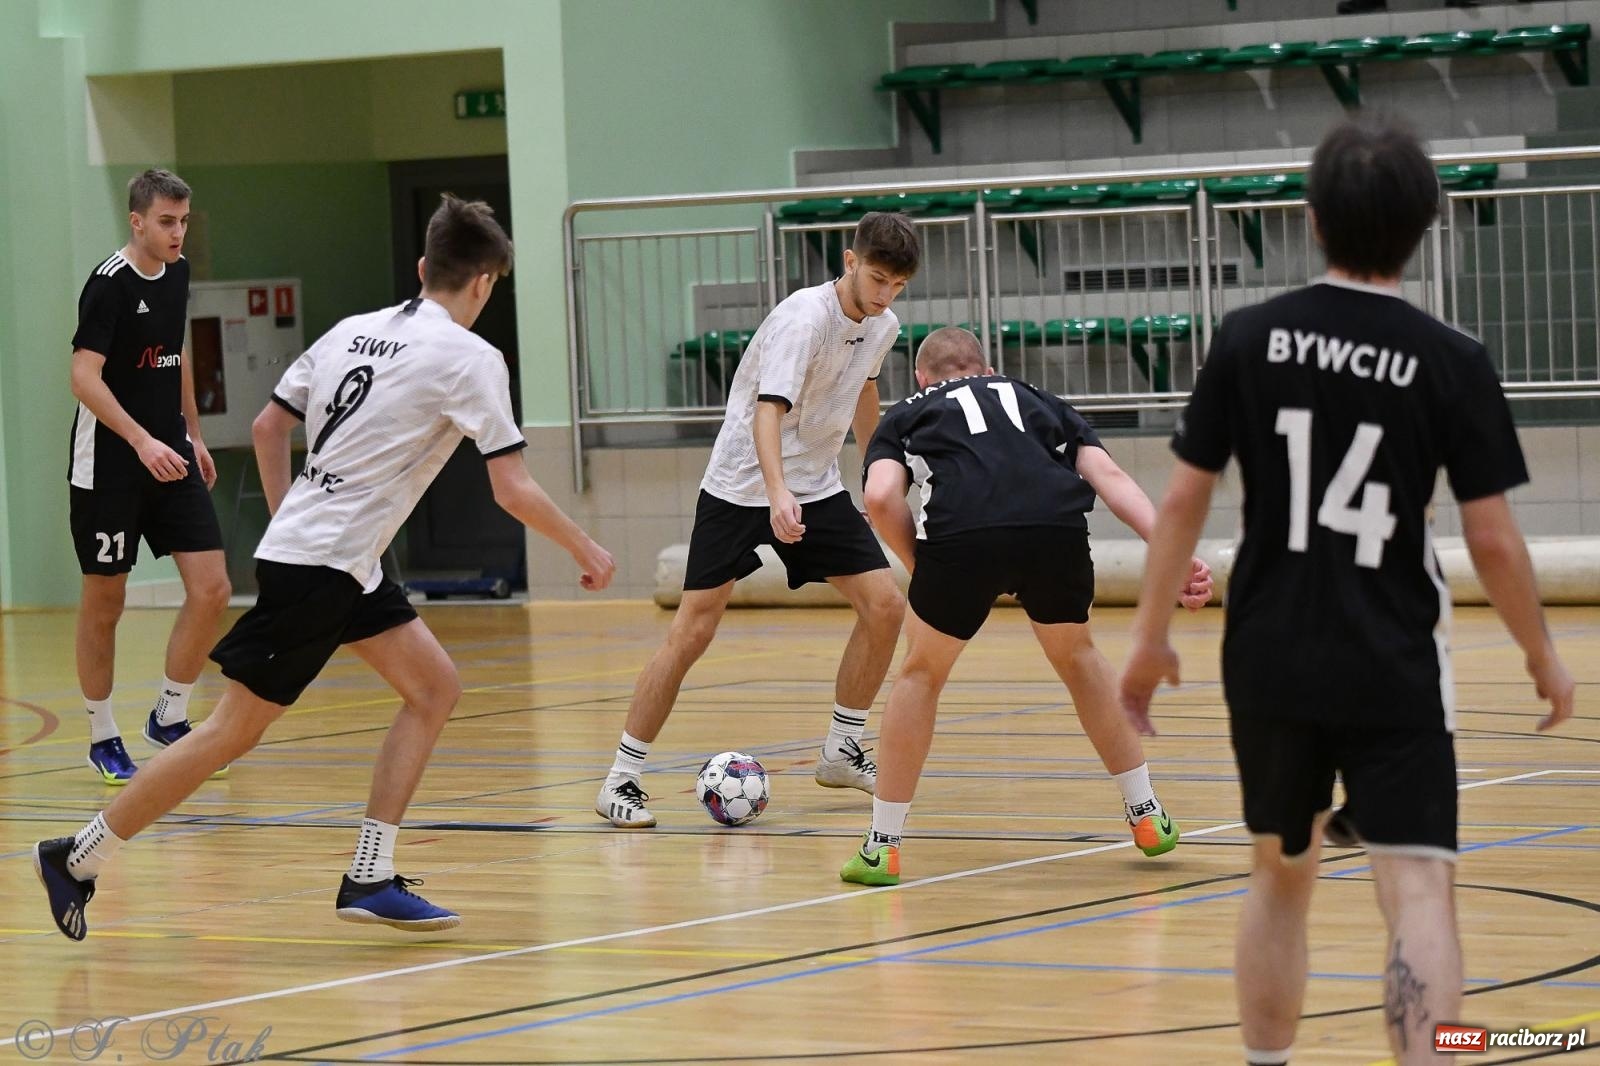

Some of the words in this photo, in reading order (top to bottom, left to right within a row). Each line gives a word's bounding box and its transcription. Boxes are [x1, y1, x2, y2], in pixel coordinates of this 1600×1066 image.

[347, 335, 408, 359] SIWY
[1266, 327, 1420, 388] BYWCIU
[310, 364, 375, 456] 9
[945, 381, 1026, 436] 11
[1274, 407, 1398, 570] 14
[95, 530, 125, 563] 21
